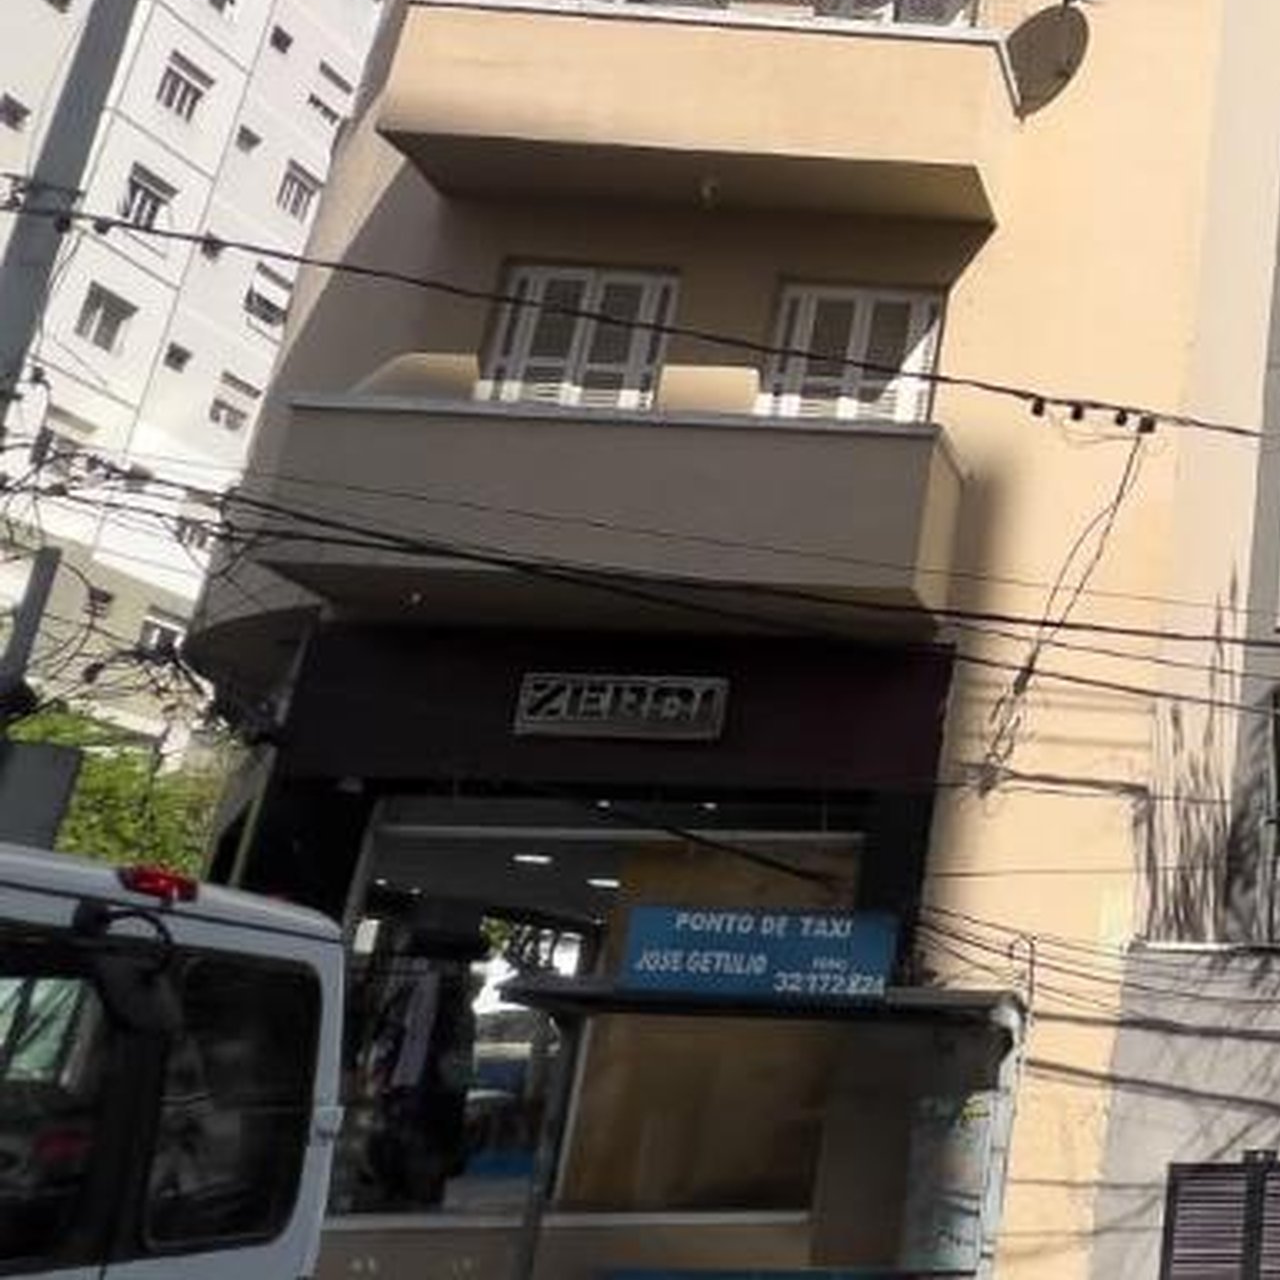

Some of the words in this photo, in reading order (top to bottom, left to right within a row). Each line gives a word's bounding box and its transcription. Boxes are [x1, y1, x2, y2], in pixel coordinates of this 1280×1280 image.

[676, 912, 752, 935] PONTO
[762, 916, 788, 937] DE
[801, 918, 853, 938] TAXI
